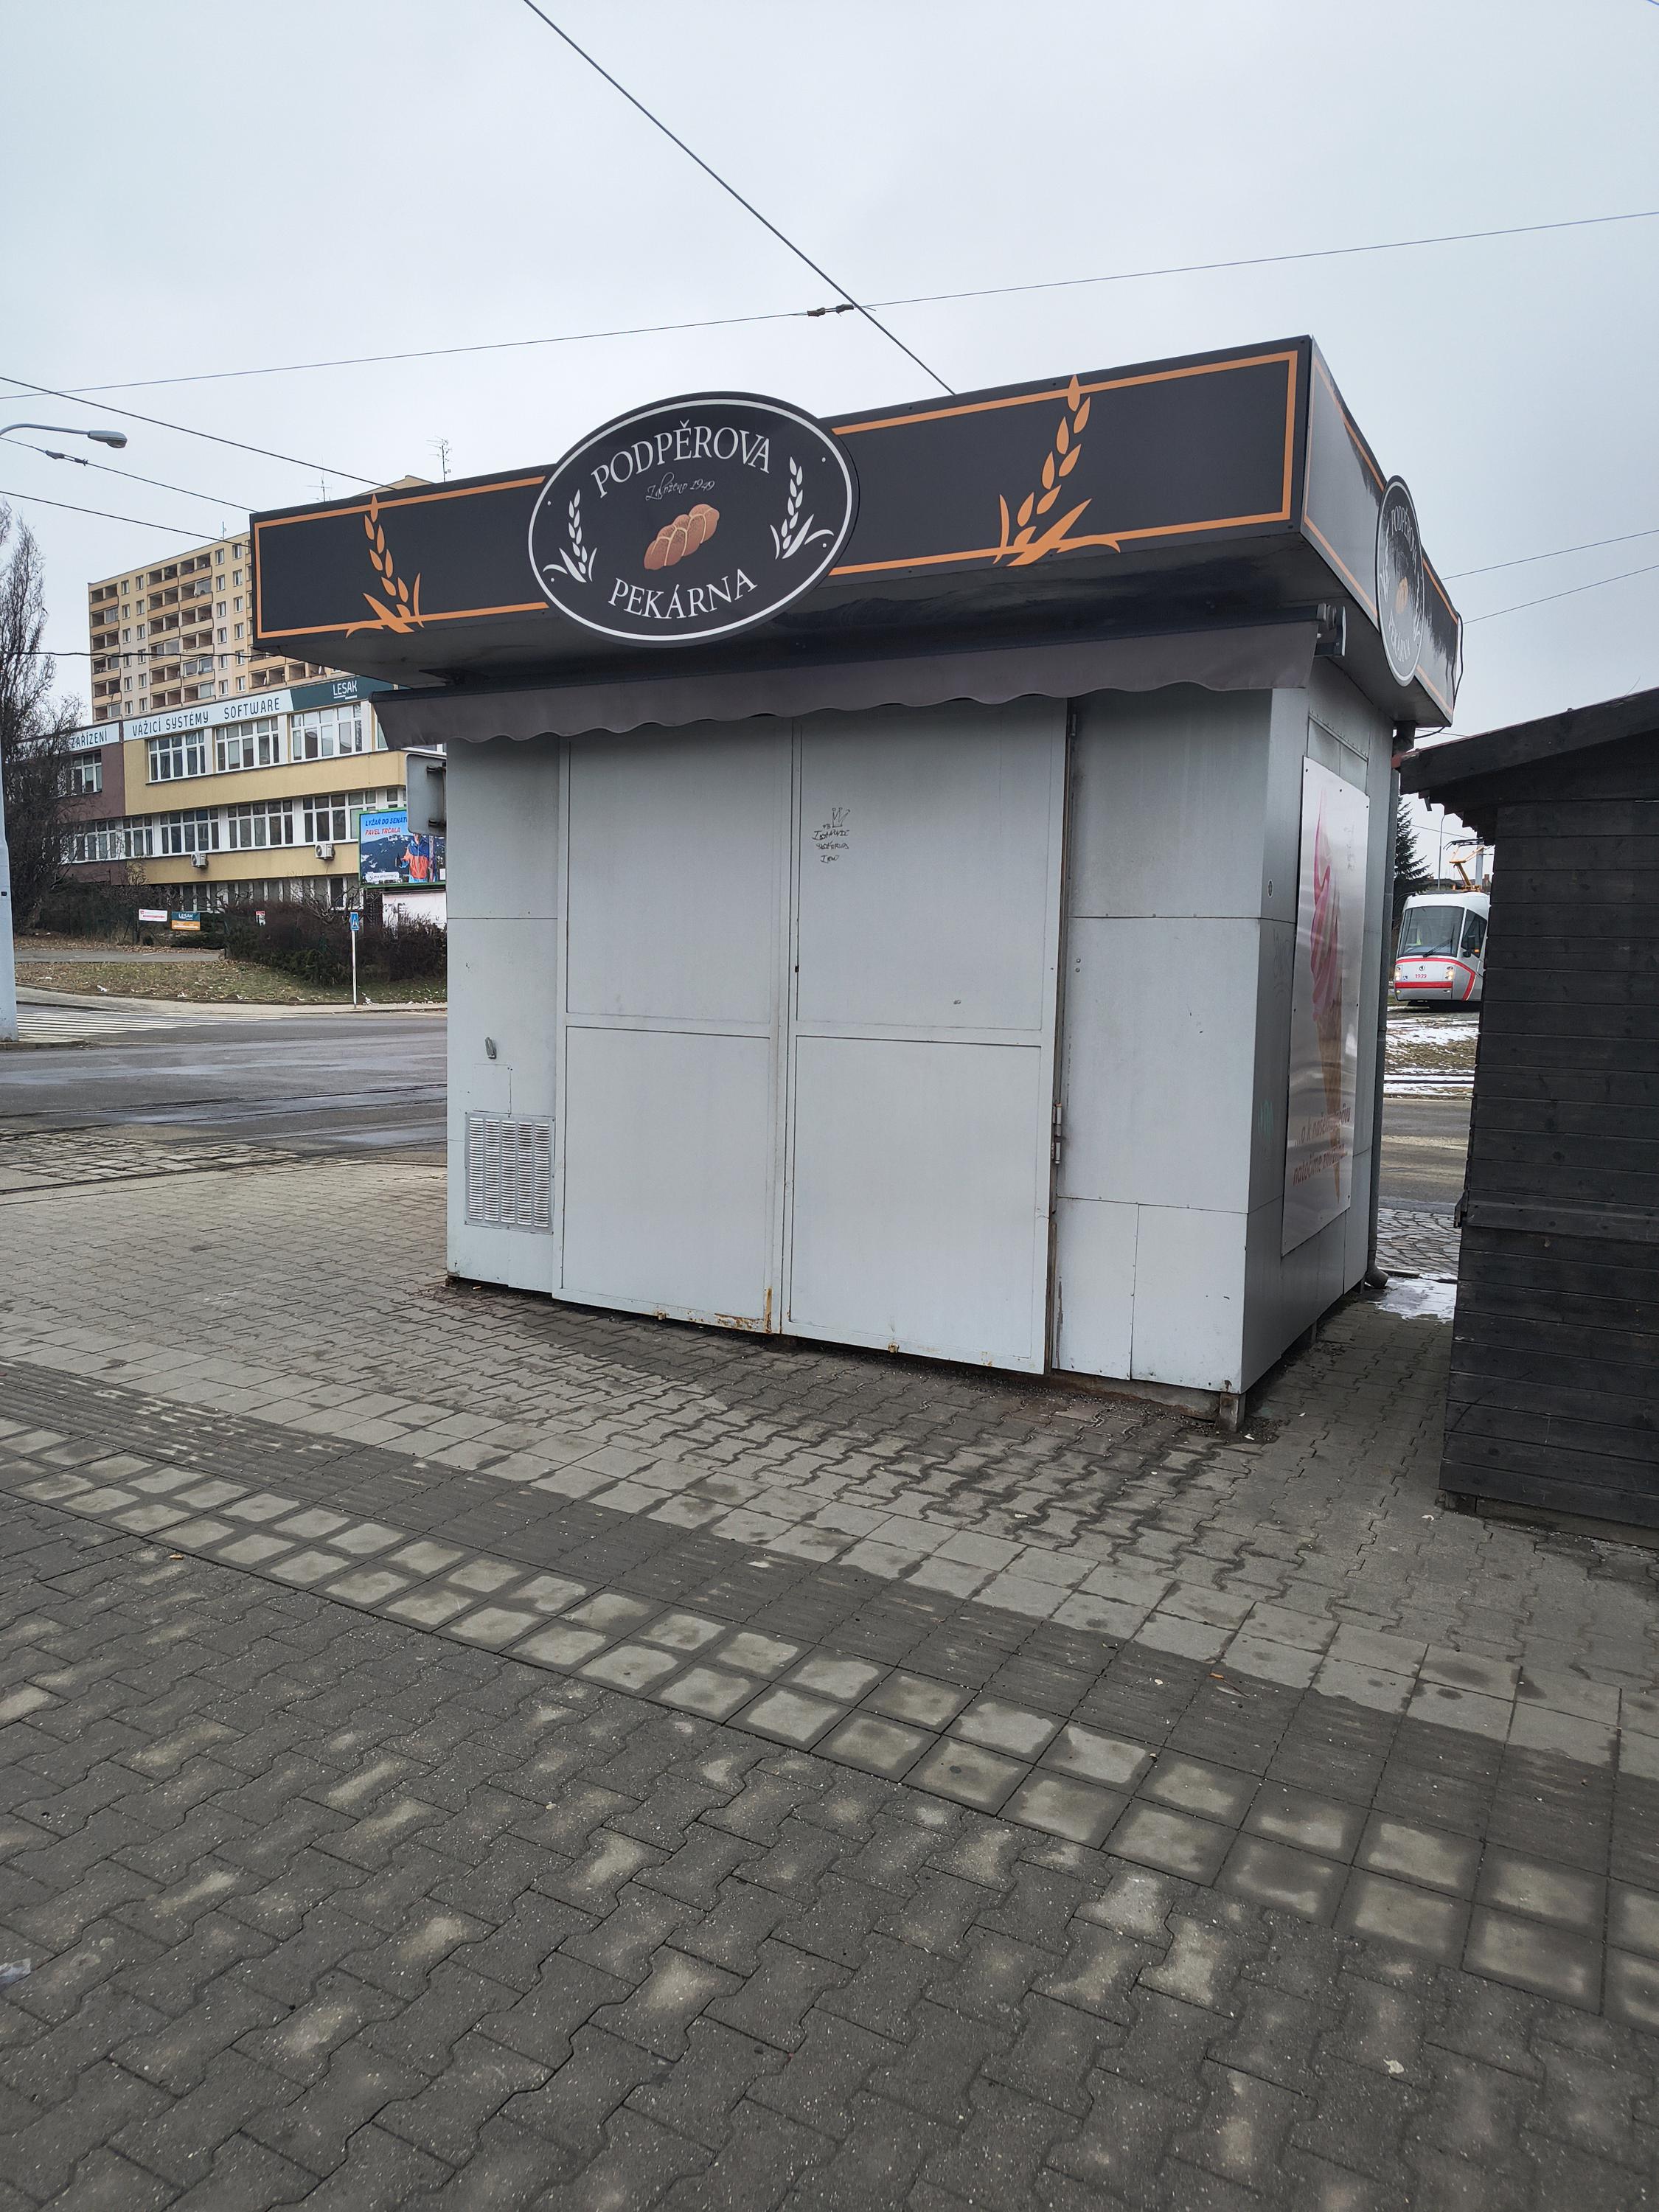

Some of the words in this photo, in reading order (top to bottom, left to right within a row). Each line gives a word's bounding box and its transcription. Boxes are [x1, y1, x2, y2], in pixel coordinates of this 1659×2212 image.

[591, 420, 769, 498] PODPĚROVA
[690, 479, 715, 490] 1949
[608, 568, 758, 619] PEKÁRNA
[333, 680, 358, 696] LESAK
[132, 717, 161, 736] VÁŽICÍ
[166, 711, 209, 731] SYSTÉMY
[224, 698, 279, 720] SOFTWARE
[70, 728, 108, 748] ZAŘÍZENÍ
